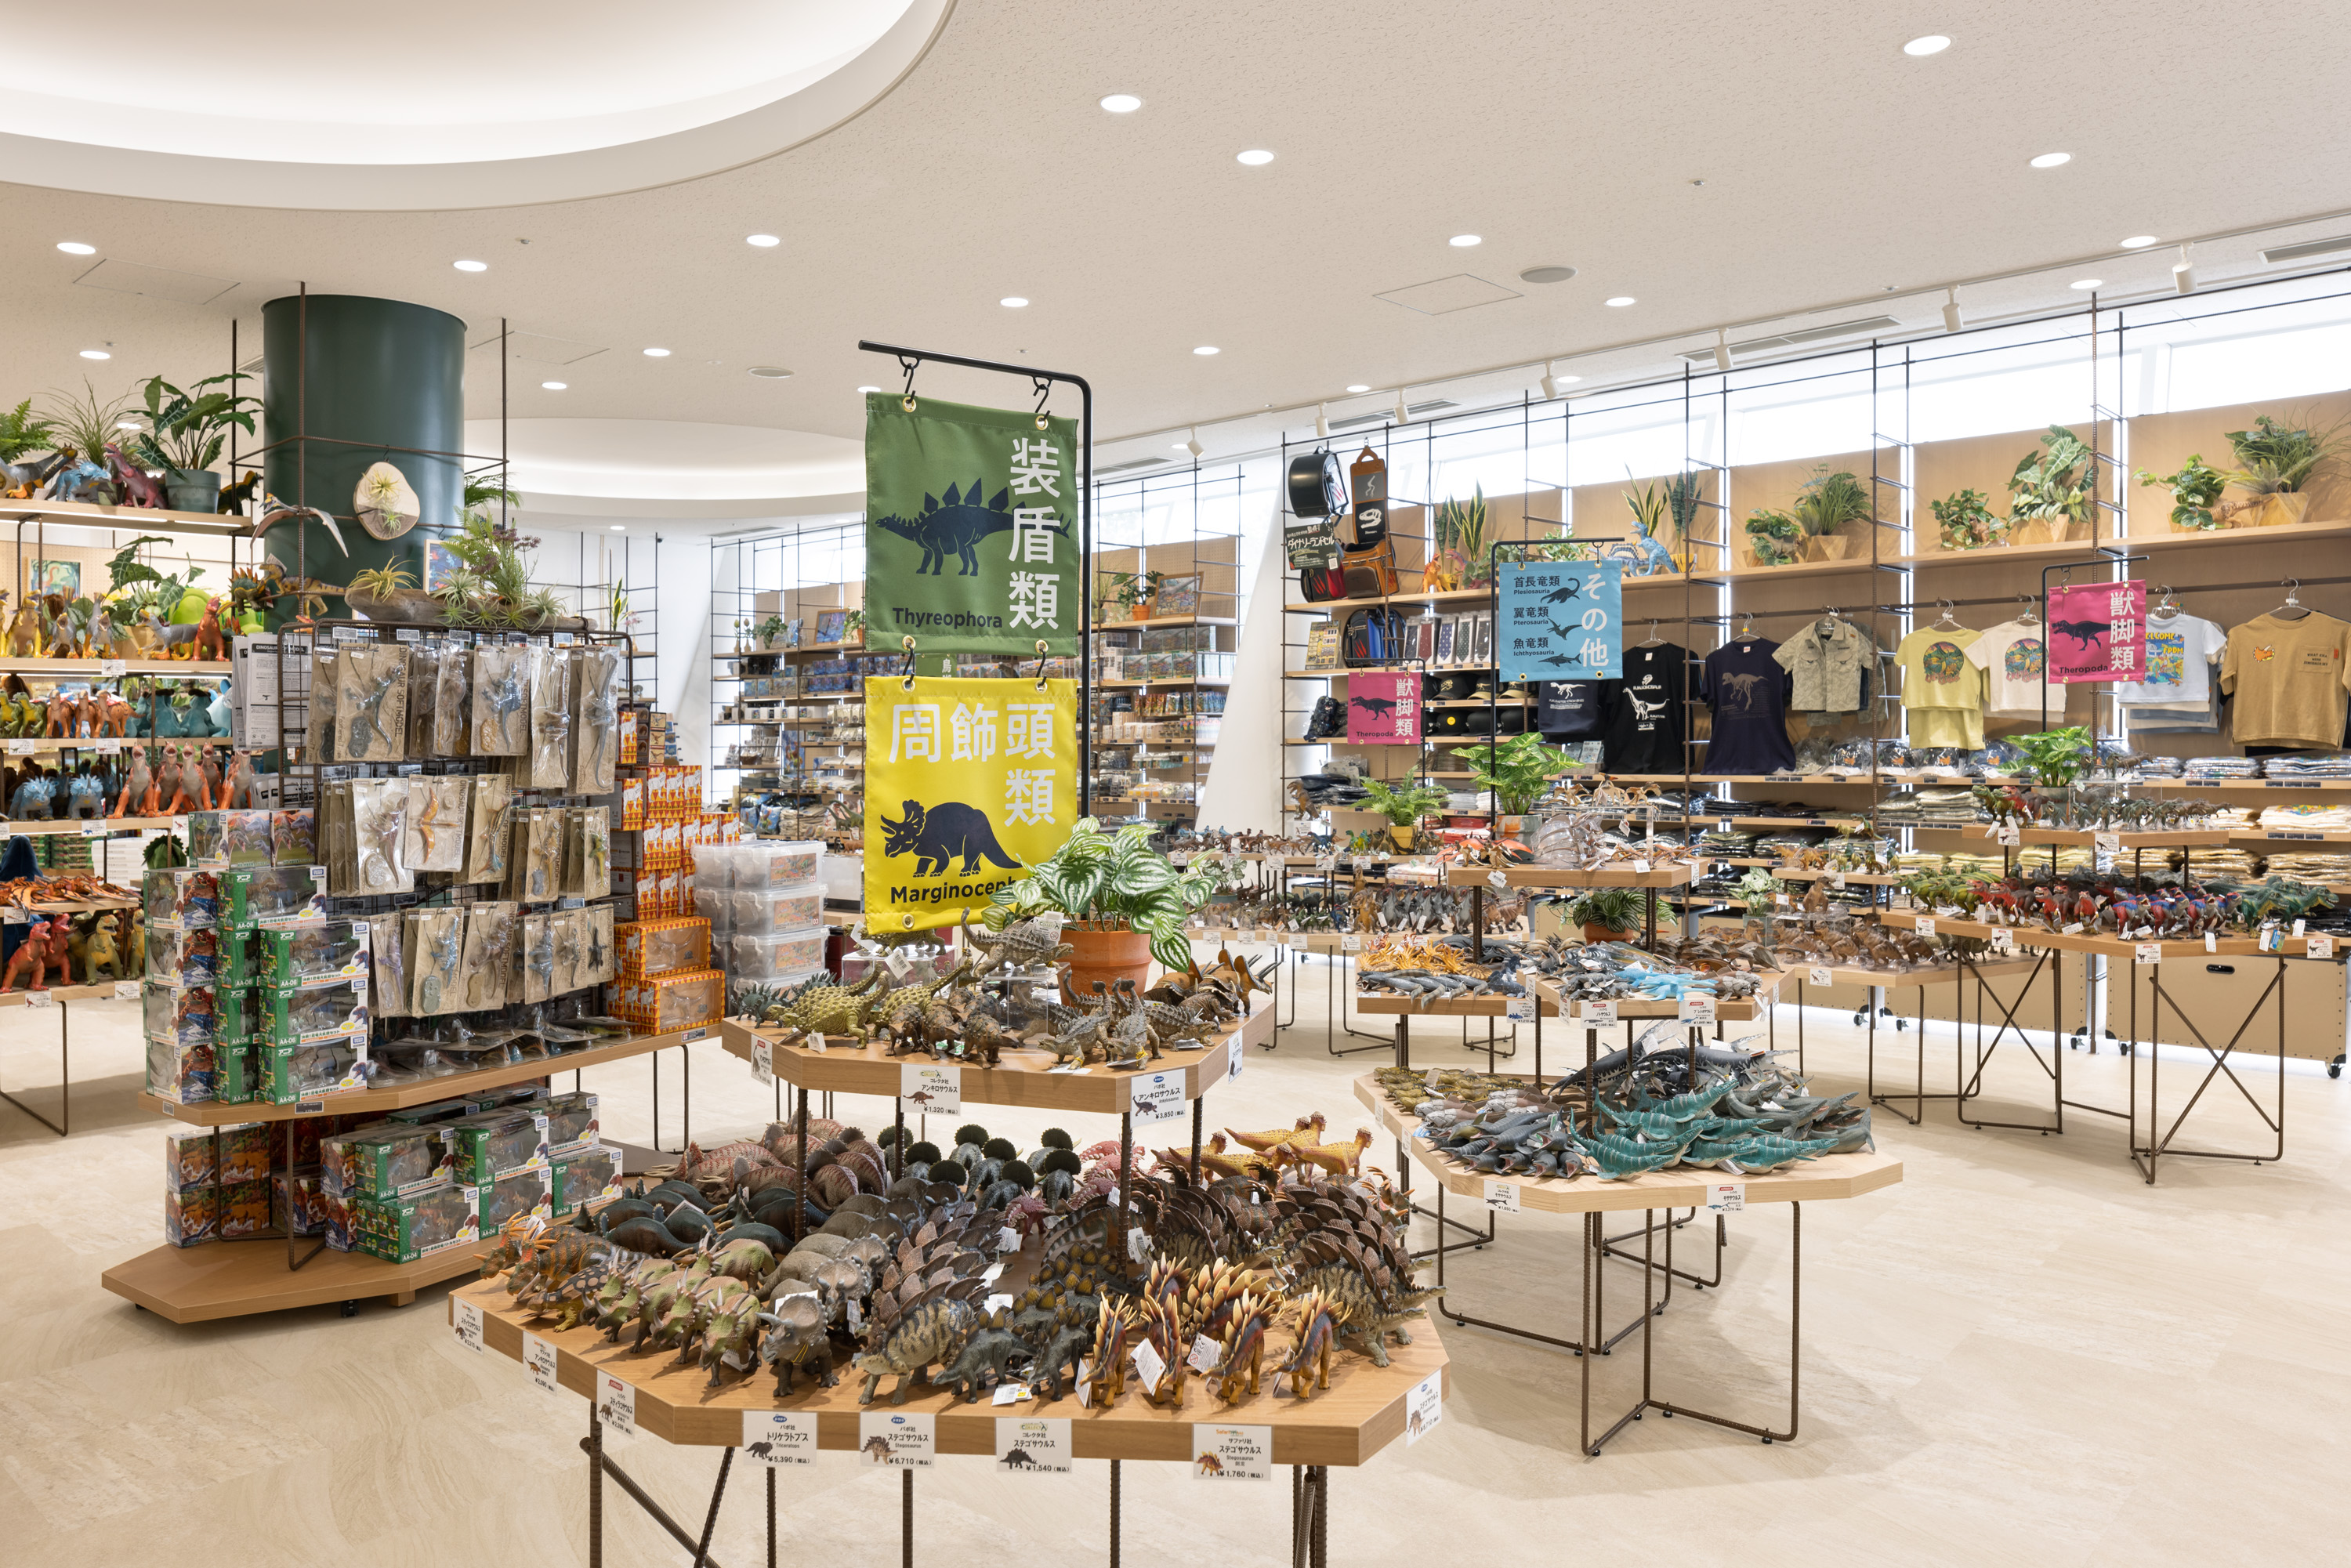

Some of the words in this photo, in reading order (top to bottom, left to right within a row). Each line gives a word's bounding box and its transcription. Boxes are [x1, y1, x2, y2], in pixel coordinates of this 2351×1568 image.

[1009, 437, 1060, 631] 装盾類
[1513, 575, 1560, 588] 首長竜類
[892, 607, 1003, 630] Thyreophora
[1513, 606, 1549, 619] 翼竜類
[1580, 573, 1609, 667] その他
[2110, 591, 2135, 672] 獣脚類
[1513, 636, 1549, 649] 魚竜類
[2059, 664, 2108, 674] Theropoda
[1395, 678, 1414, 737] 獣脚類
[1139, 1088, 1180, 1101] アンキロサウルス
[767, 1432, 809, 1441] トリケラトプス
[1219, 1445, 1261, 1454] ステゴサウルス
